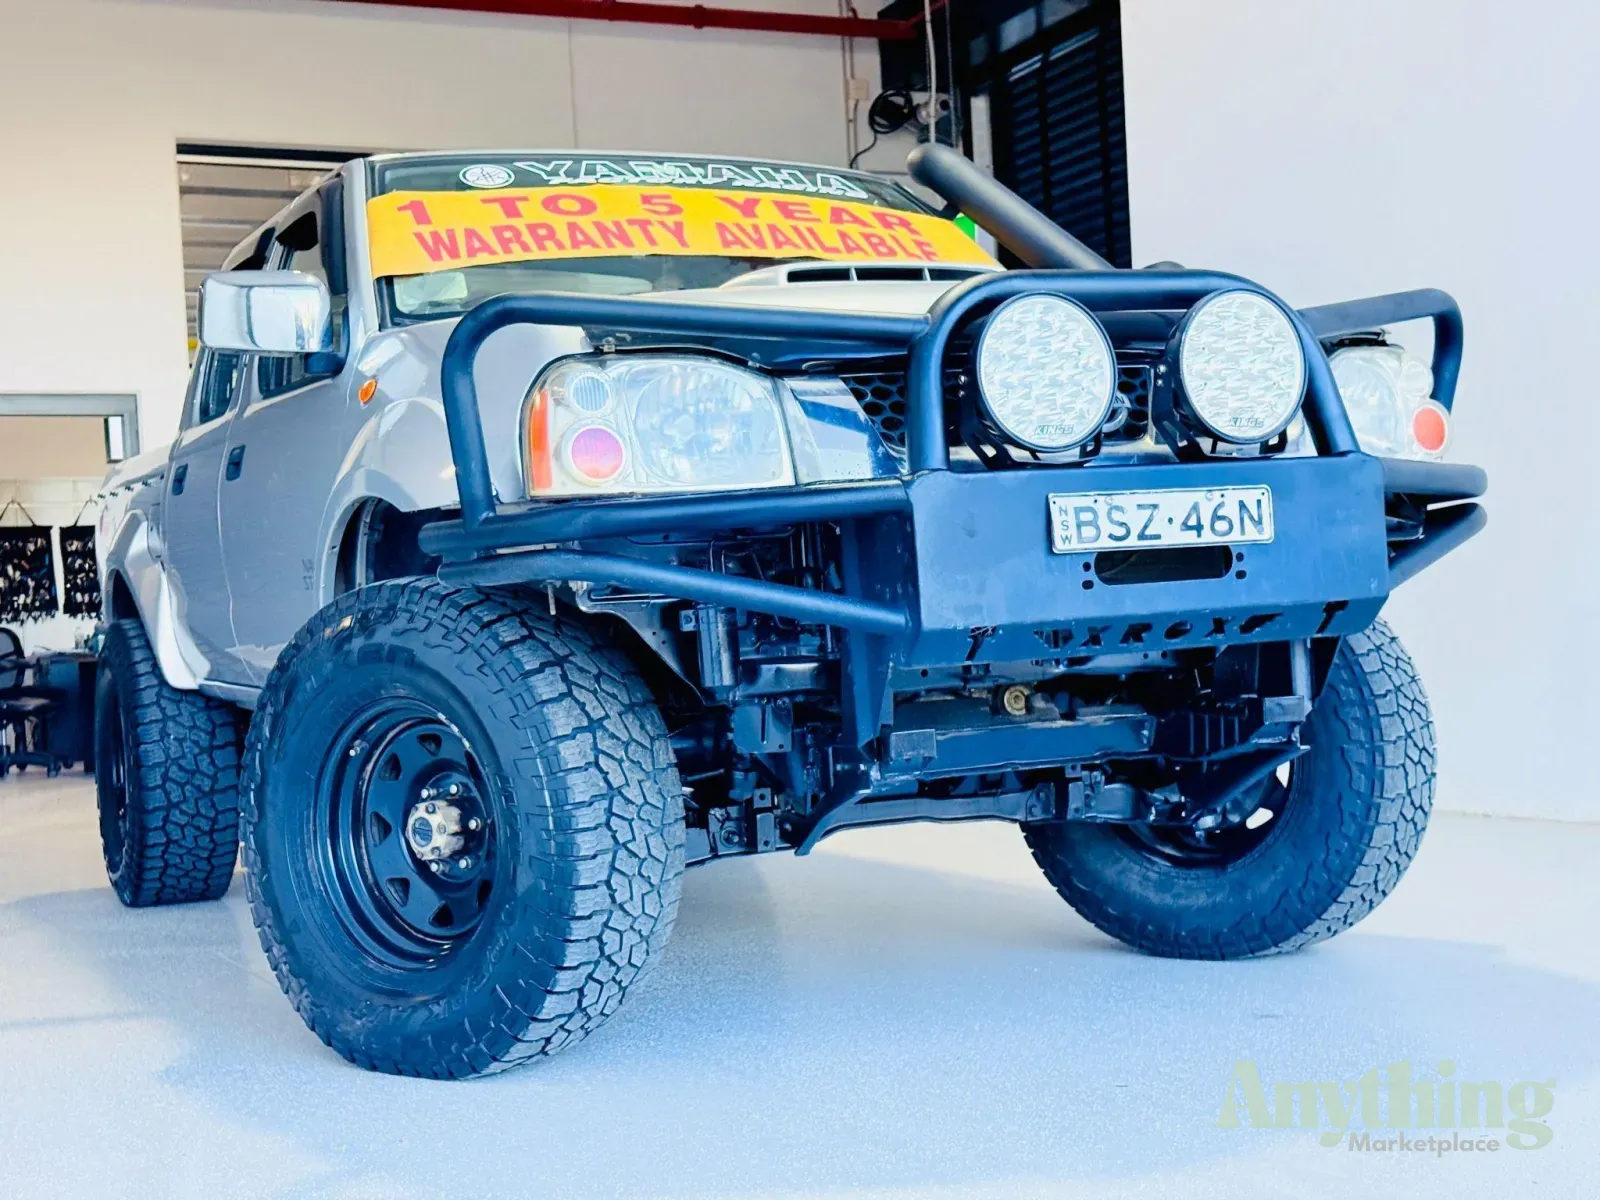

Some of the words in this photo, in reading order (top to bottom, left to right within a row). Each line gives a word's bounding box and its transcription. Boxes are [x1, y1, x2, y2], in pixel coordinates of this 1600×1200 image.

[513, 160, 868, 199] YAMAHA
[397, 200, 432, 225] 1
[480, 194, 598, 219] TO
[640, 194, 684, 216] 5
[714, 196, 922, 236] YEAR
[412, 218, 690, 262] WARRANTY
[715, 221, 939, 262] AVAILABLE
[1033, 424, 1074, 436] KINGS
